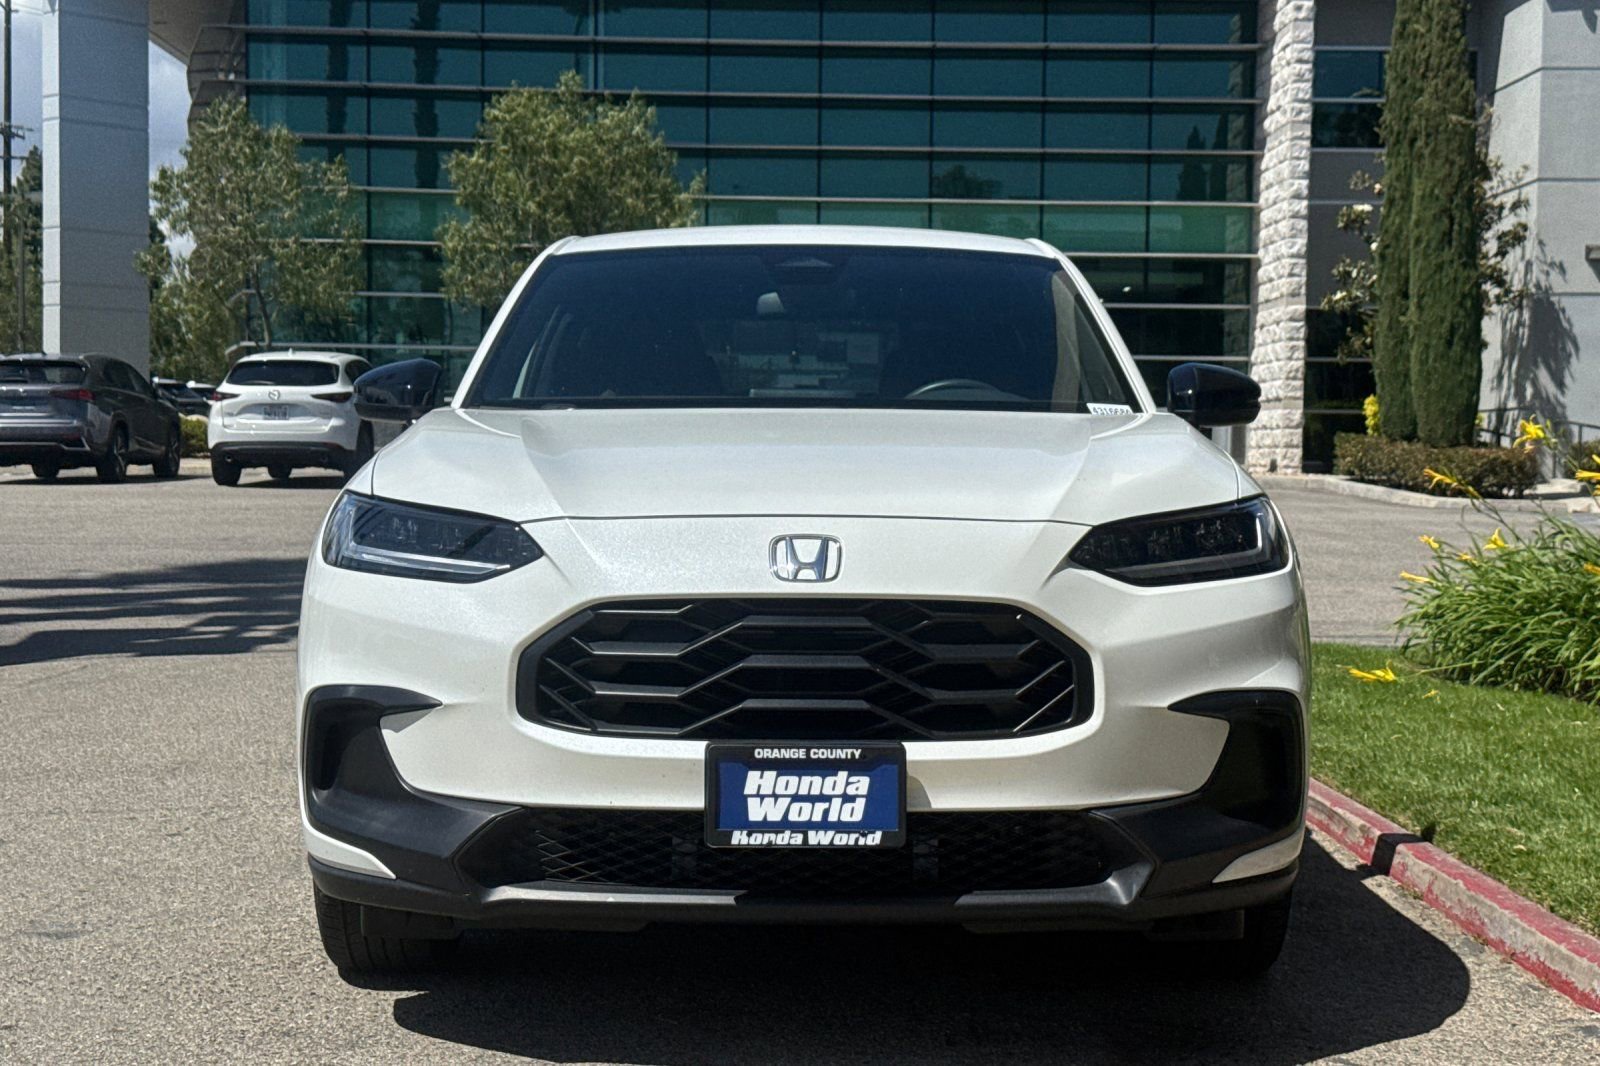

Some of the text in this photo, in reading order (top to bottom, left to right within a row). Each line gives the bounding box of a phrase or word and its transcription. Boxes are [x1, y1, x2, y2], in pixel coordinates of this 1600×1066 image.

[754, 748, 862, 759] ORANGE COUNTY
[743, 770, 871, 795] Honda
[747, 797, 867, 822] World
[731, 830, 803, 845] Honda
